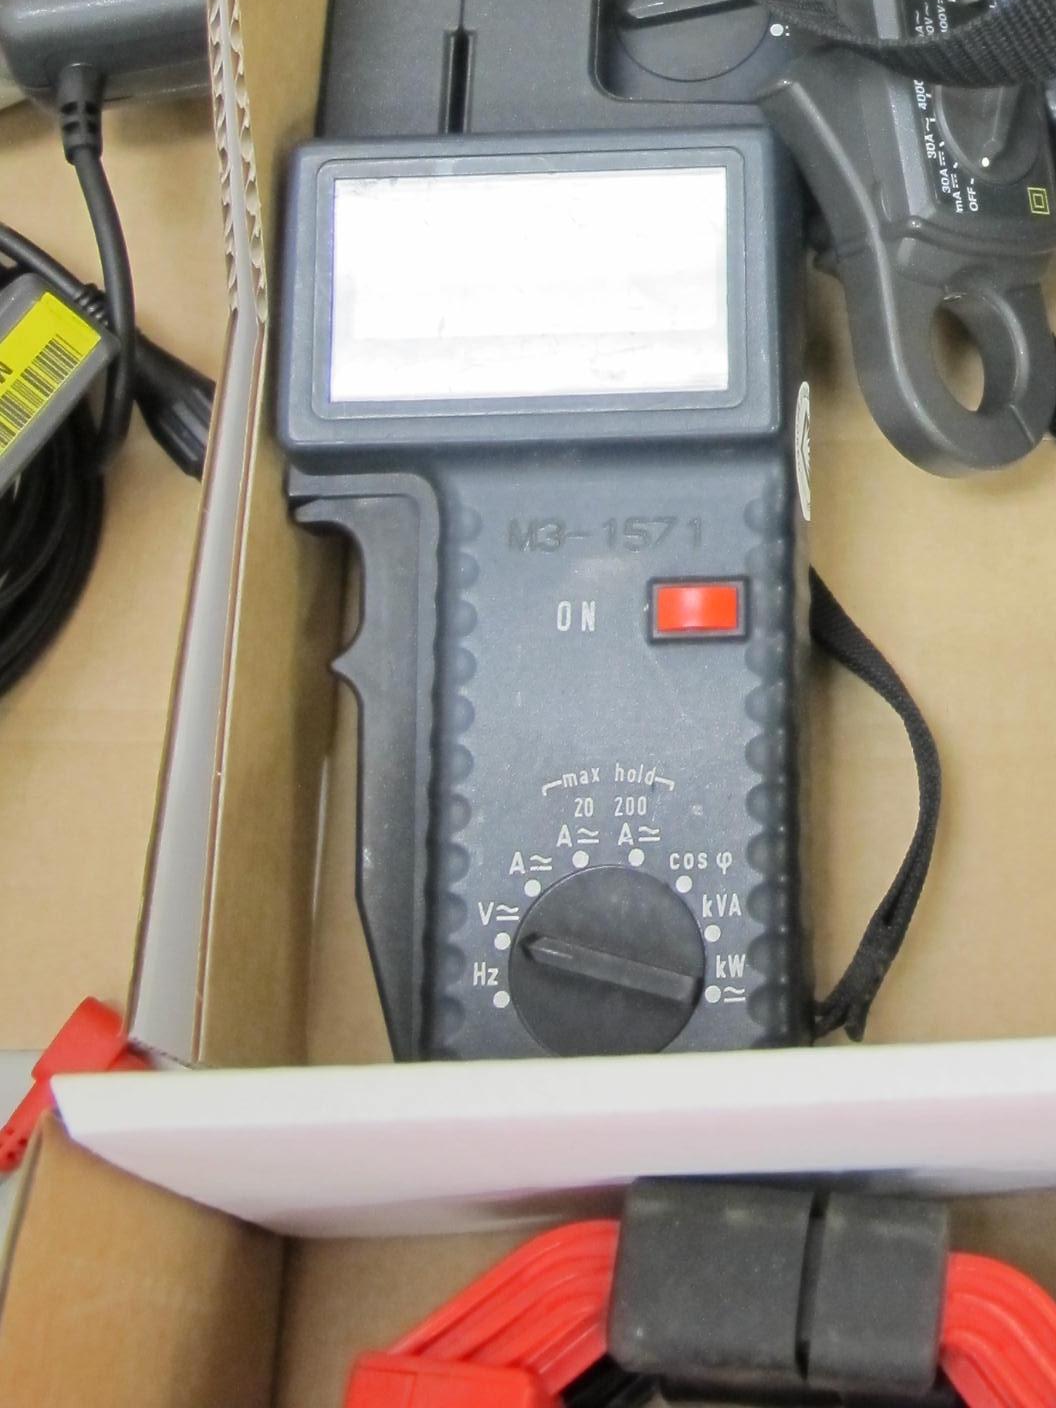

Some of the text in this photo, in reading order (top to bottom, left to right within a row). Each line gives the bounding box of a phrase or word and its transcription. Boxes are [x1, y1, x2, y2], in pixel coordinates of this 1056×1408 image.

[967, 186, 979, 212] OFF
[507, 515, 703, 554] M3-1571
[556, 600, 596, 632] ON
[561, 762, 657, 788] max hold
[574, 796, 647, 818] 20 200
[669, 852, 708, 871] cos
[701, 893, 742, 918] kVA
[472, 961, 500, 987] Hz
[715, 953, 746, 979] kW
